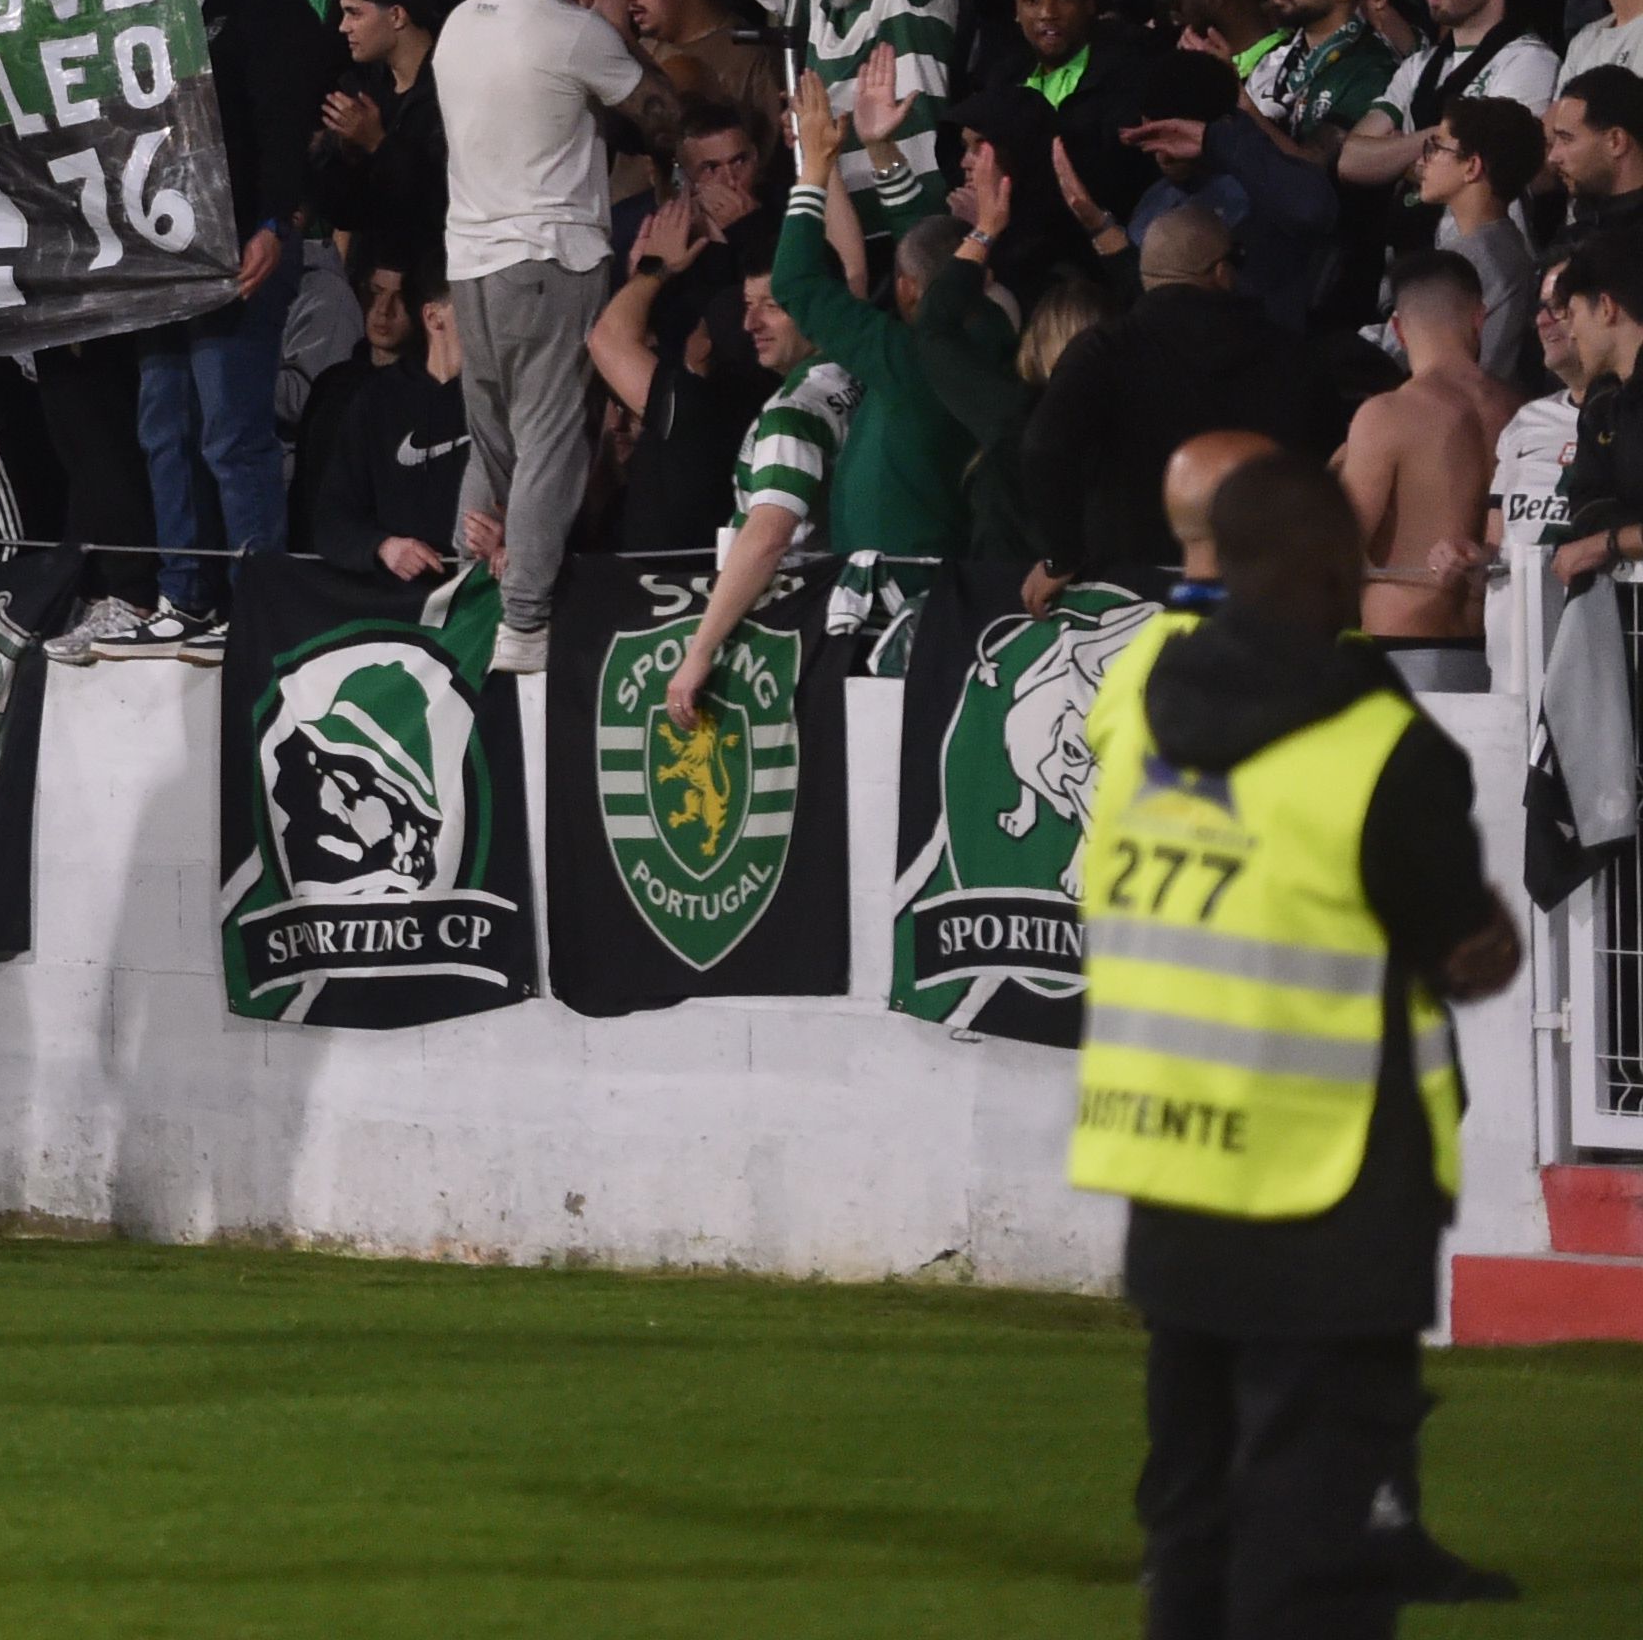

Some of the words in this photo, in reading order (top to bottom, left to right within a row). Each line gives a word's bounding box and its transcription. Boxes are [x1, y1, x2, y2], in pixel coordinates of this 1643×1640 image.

[47, 124, 197, 272] 76
[631, 858, 775, 921] PORTUGAL
[1107, 837, 1245, 922] 277
[267, 916, 424, 964] SPORTING
[437, 913, 493, 951] CP
[938, 913, 1084, 959] SPORTIN
